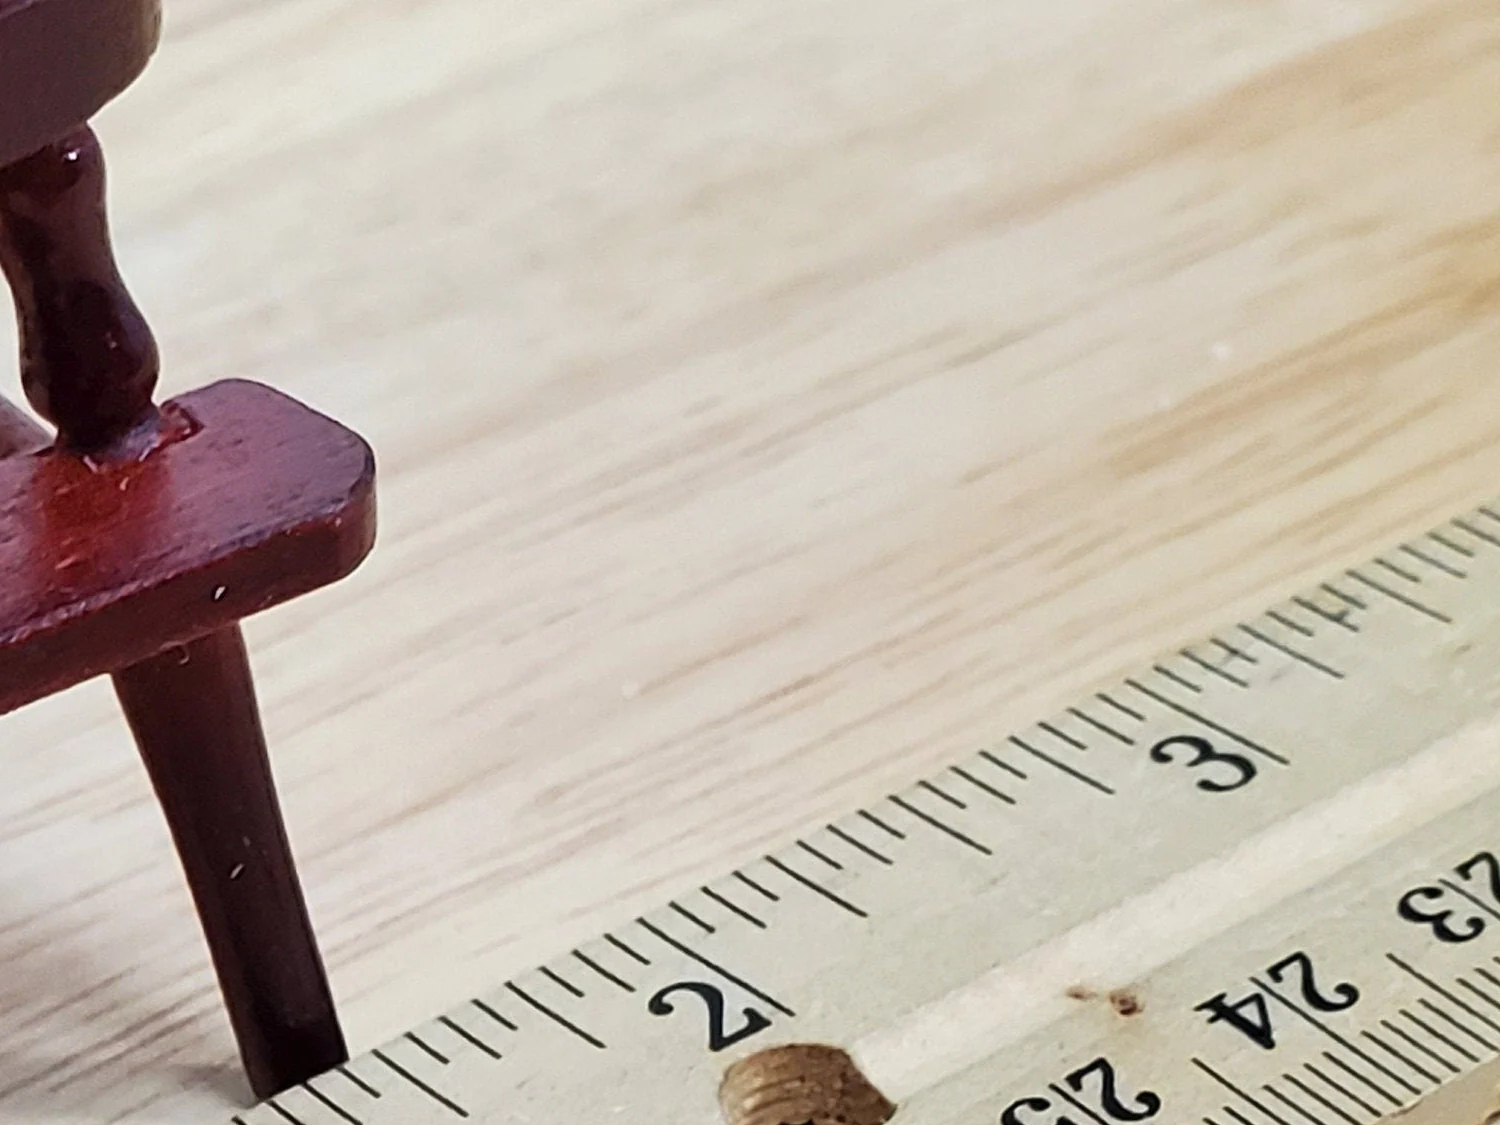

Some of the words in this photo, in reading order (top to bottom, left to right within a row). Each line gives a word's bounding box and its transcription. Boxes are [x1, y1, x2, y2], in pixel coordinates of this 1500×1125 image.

[1149, 733, 1259, 793] 3
[647, 980, 772, 1052] 2
[1195, 951, 1360, 1050] 24
